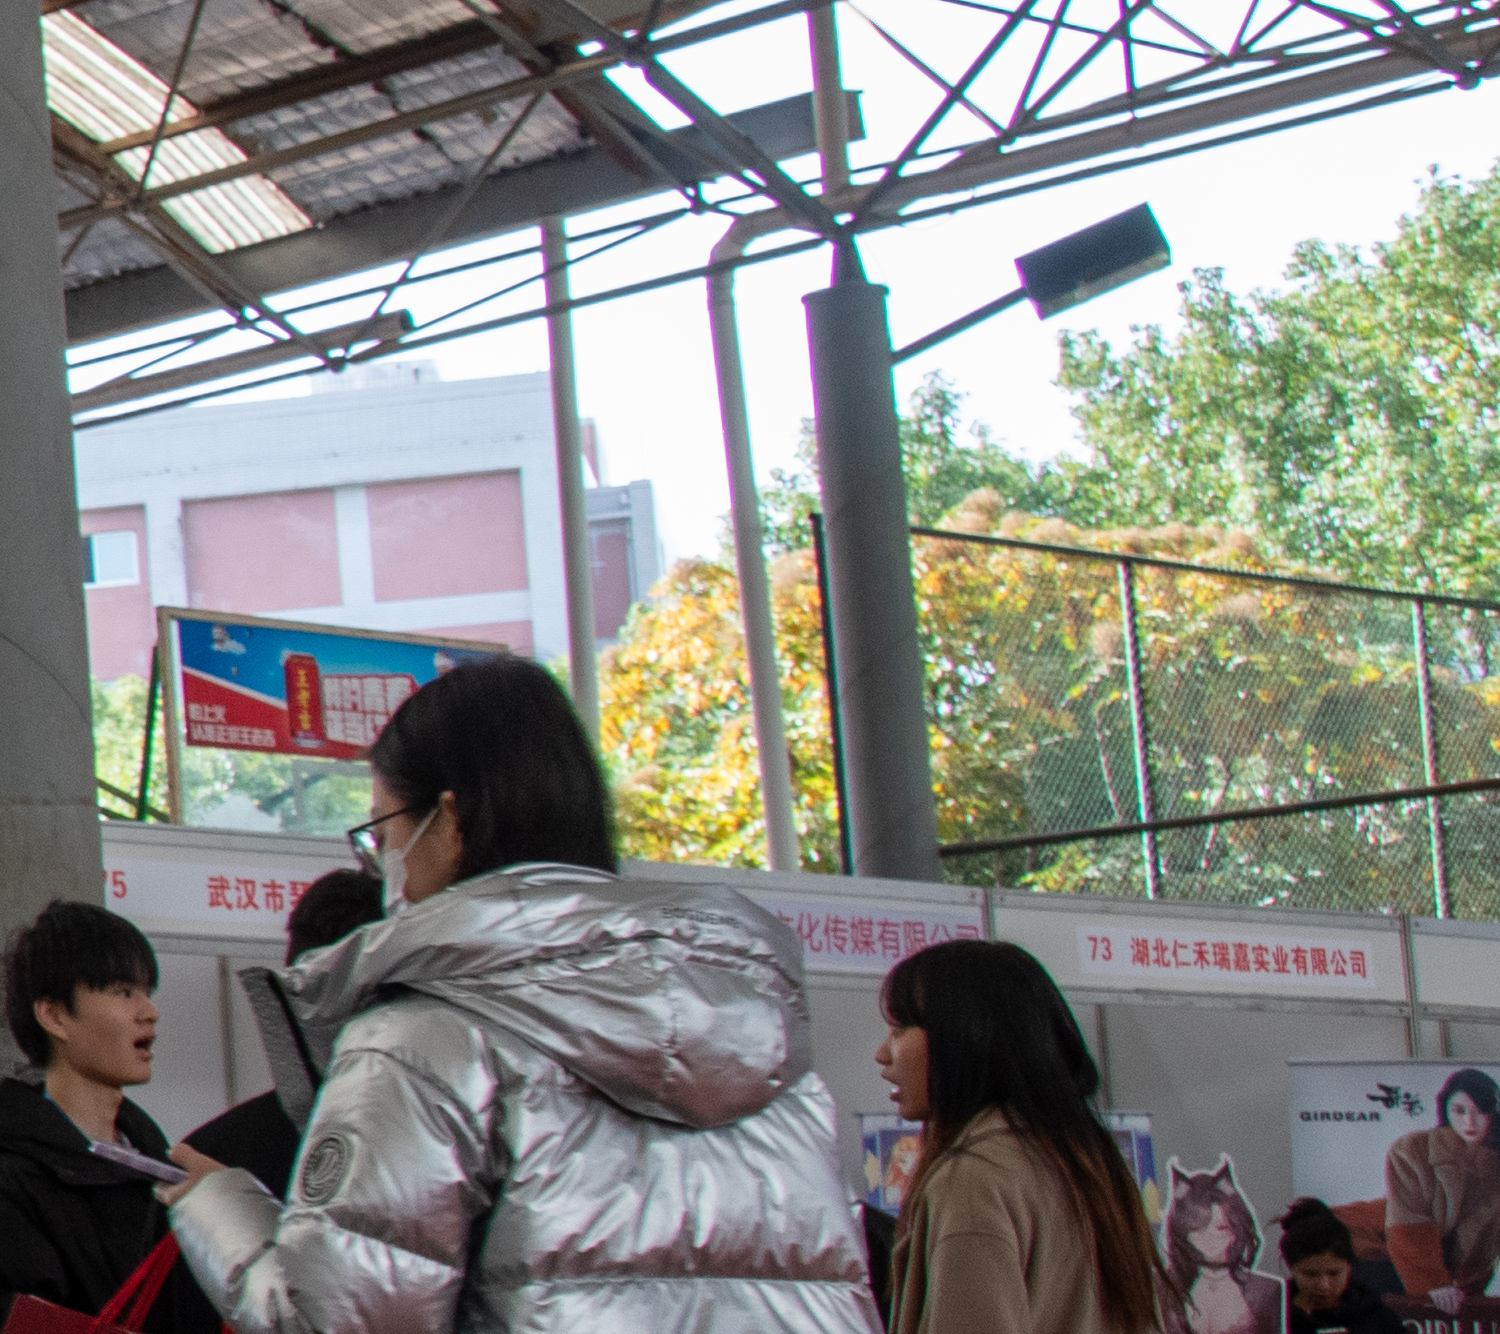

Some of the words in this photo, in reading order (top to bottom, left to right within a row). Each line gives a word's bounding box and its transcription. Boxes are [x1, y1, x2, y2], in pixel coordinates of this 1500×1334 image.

[104, 870, 128, 900] 5
[1087, 936, 1112, 961] 73
[1300, 1110, 1382, 1122] GIRDEAR
